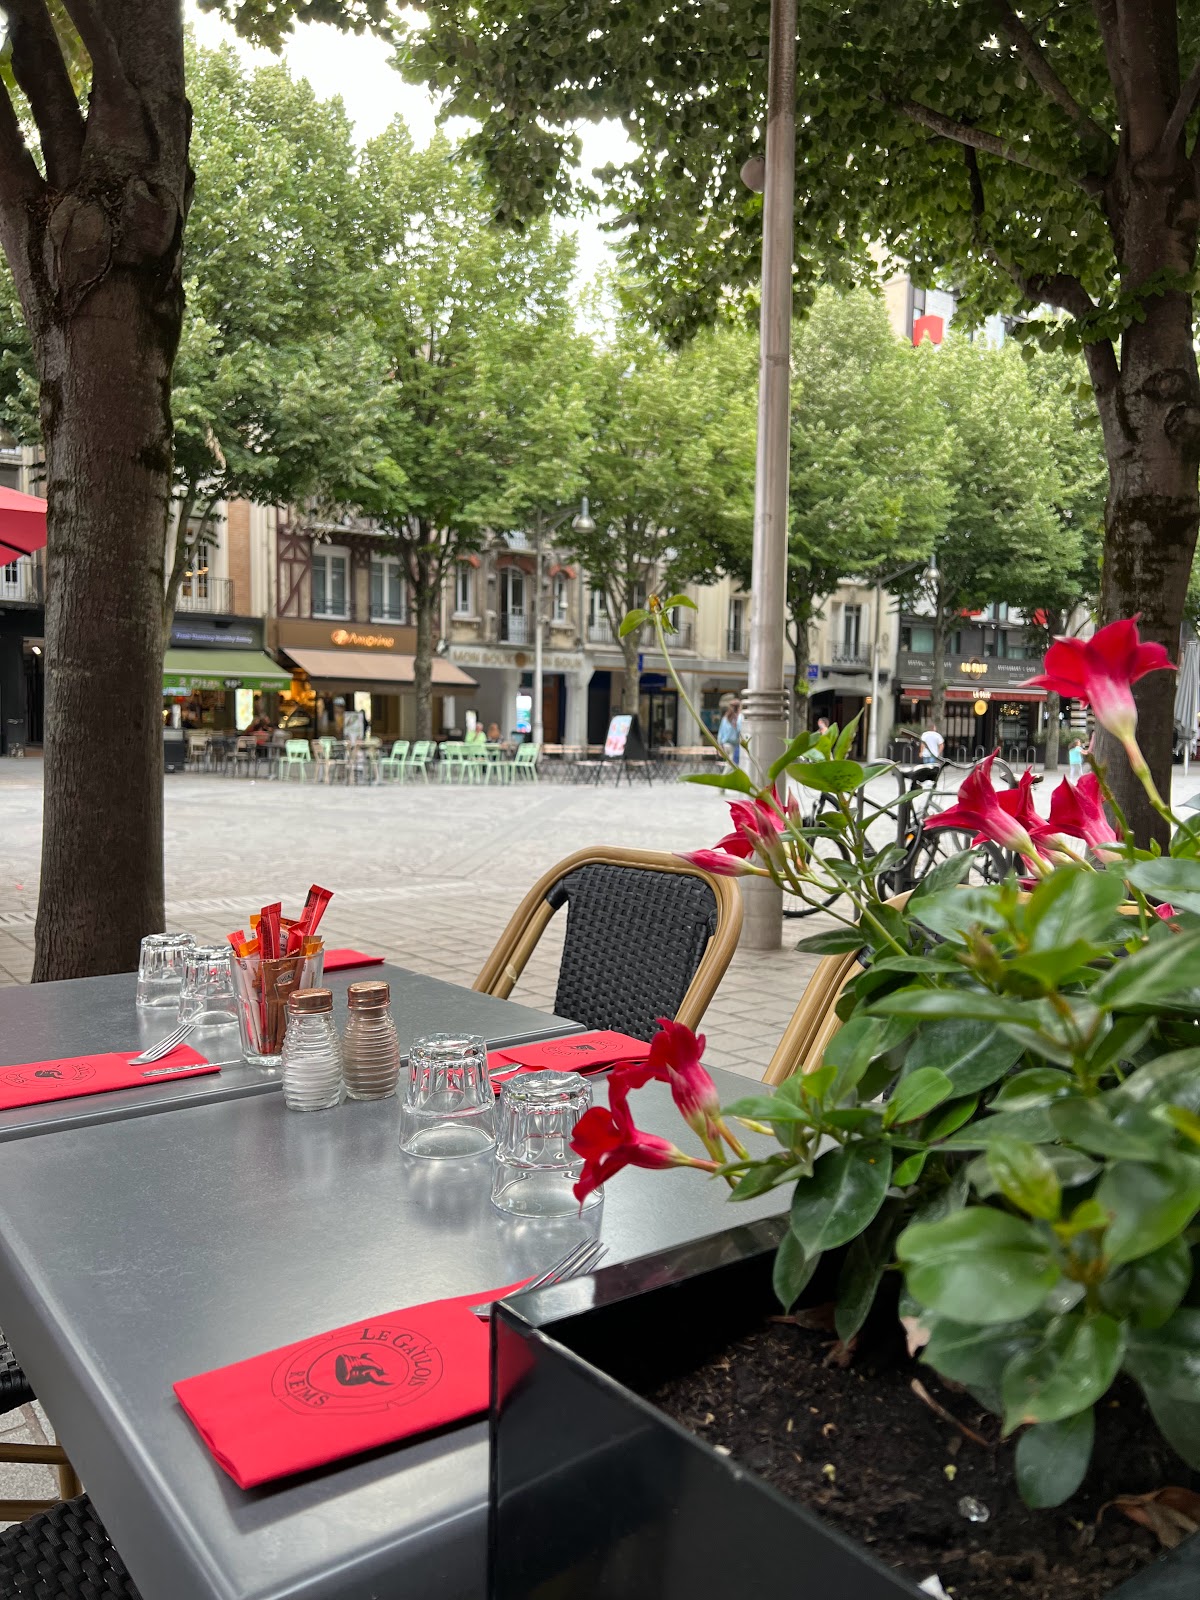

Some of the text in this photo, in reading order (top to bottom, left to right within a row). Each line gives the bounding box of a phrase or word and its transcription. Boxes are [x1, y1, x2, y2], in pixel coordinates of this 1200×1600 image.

[348, 632, 395, 648] Amorino
[360, 1328, 432, 1387] LE GAULOIS
[289, 1370, 329, 1407] REIMS
